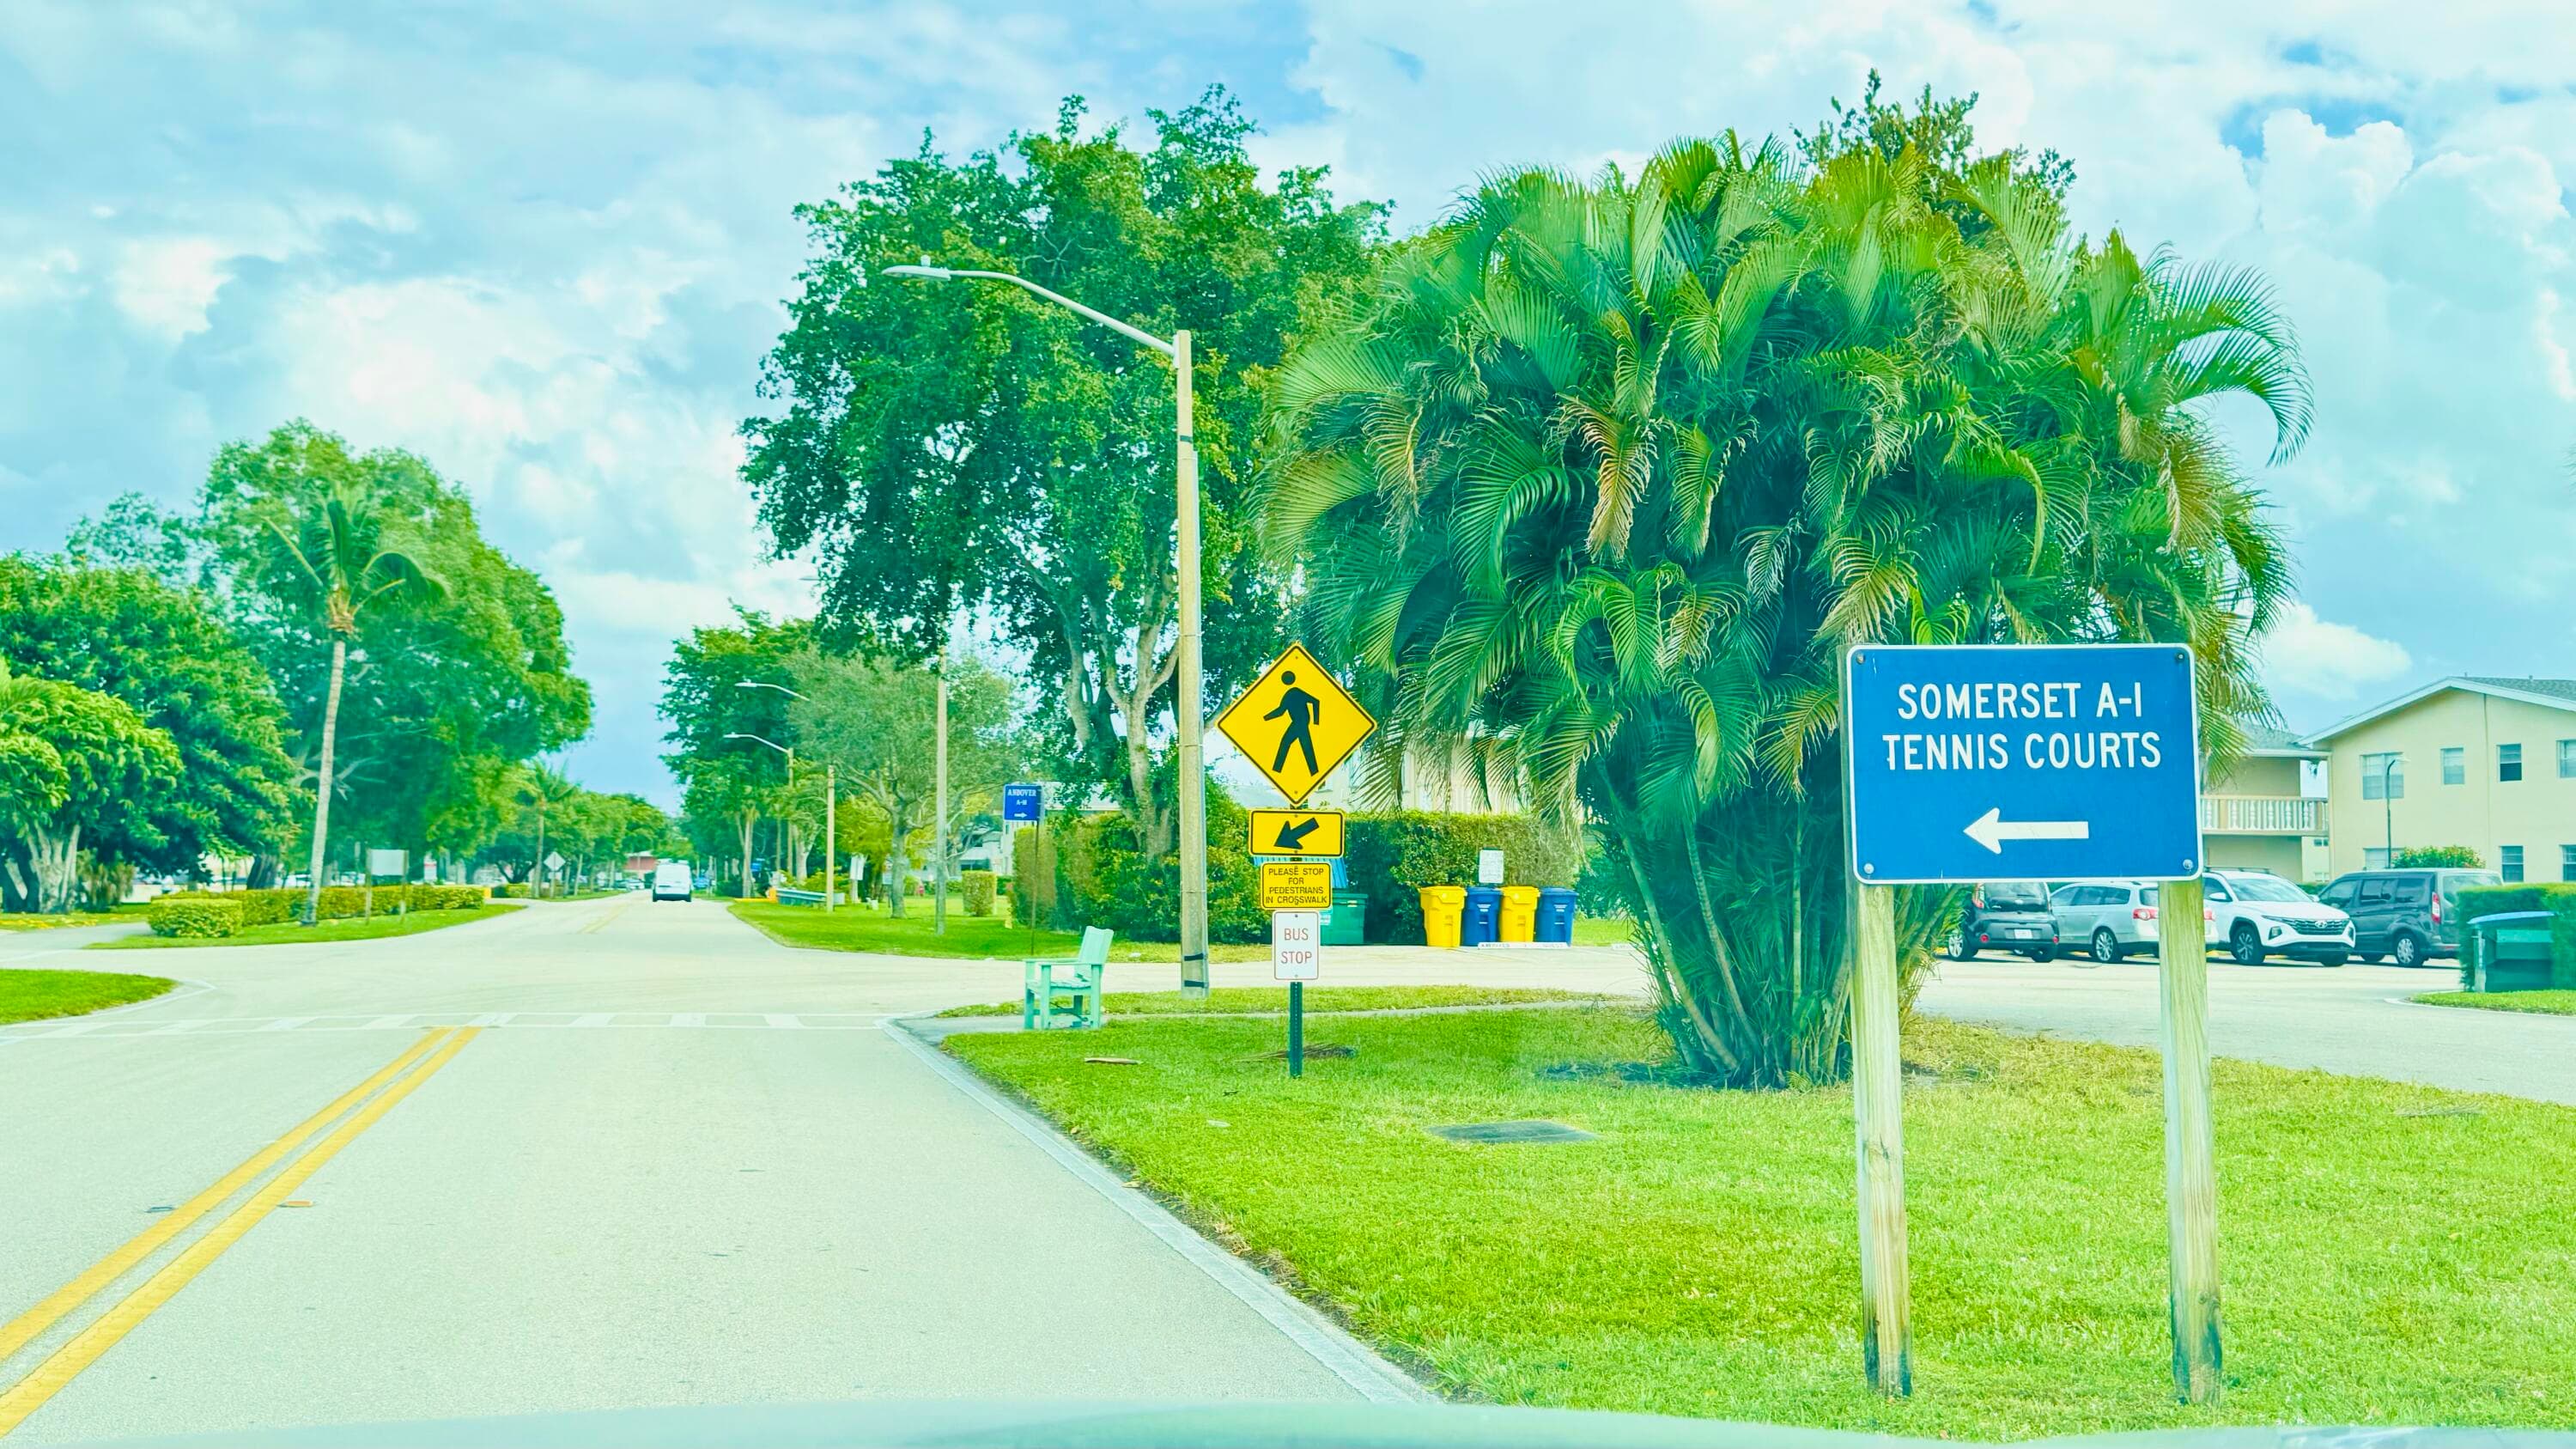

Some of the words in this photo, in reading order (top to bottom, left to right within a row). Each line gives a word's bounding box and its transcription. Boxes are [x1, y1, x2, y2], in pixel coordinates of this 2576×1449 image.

[1897, 682, 2081, 720] SOMERSET
[1881, 734, 2009, 771] TENNIS
[2024, 731, 2162, 770] COURTS
[1268, 868, 1299, 876] PLEASE
[1303, 868, 1324, 876] STOP
[1288, 877, 1304, 886] FOR
[1265, 896, 1273, 904] IN
[1277, 896, 1327, 904] CROSSWALK
[1284, 928, 1309, 941] BUS
[1280, 951, 1313, 965] STOP
